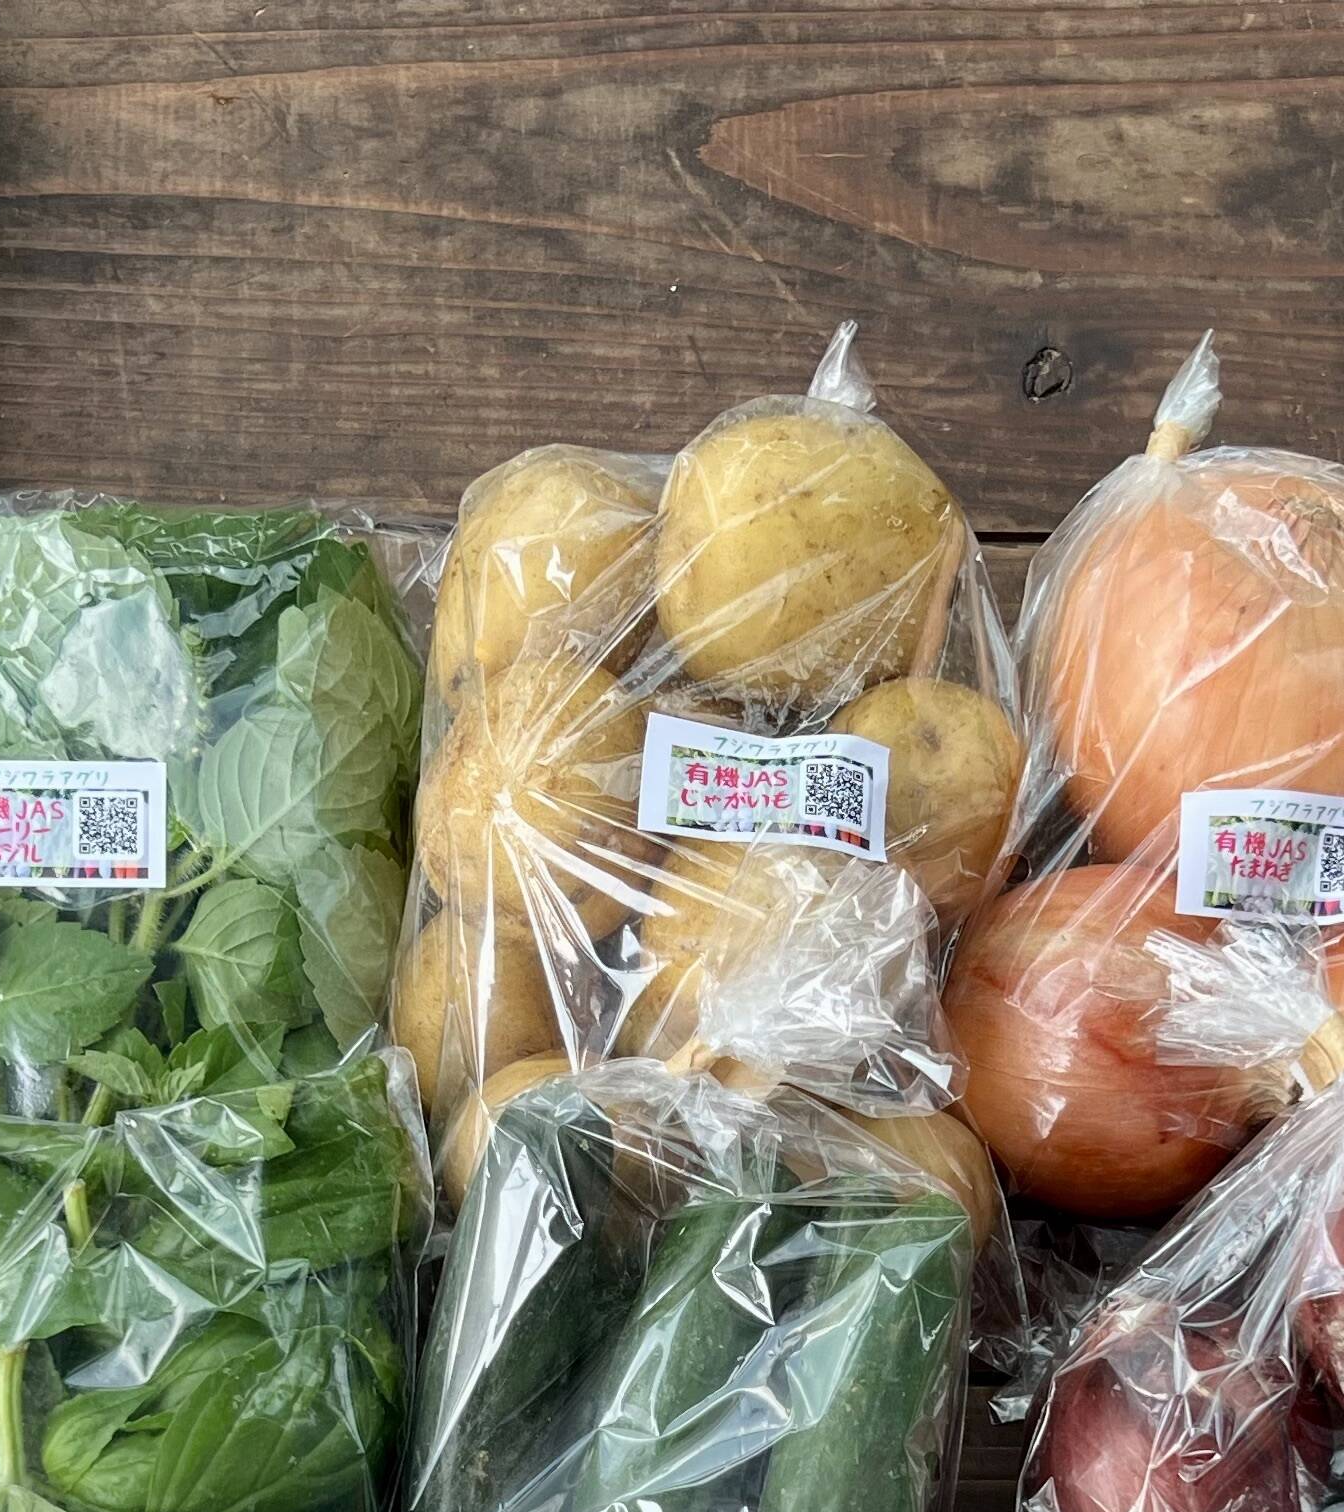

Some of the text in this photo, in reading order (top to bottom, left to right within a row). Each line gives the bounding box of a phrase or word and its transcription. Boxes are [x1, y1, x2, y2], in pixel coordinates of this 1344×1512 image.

[714, 737, 837, 754] フジワラアグリ
[685, 763, 788, 788] 有機JAS
[680, 789, 792, 809] じゃがいも
[1215, 830, 1308, 860] 有機JAS
[1230, 856, 1294, 882] たまねぎ
